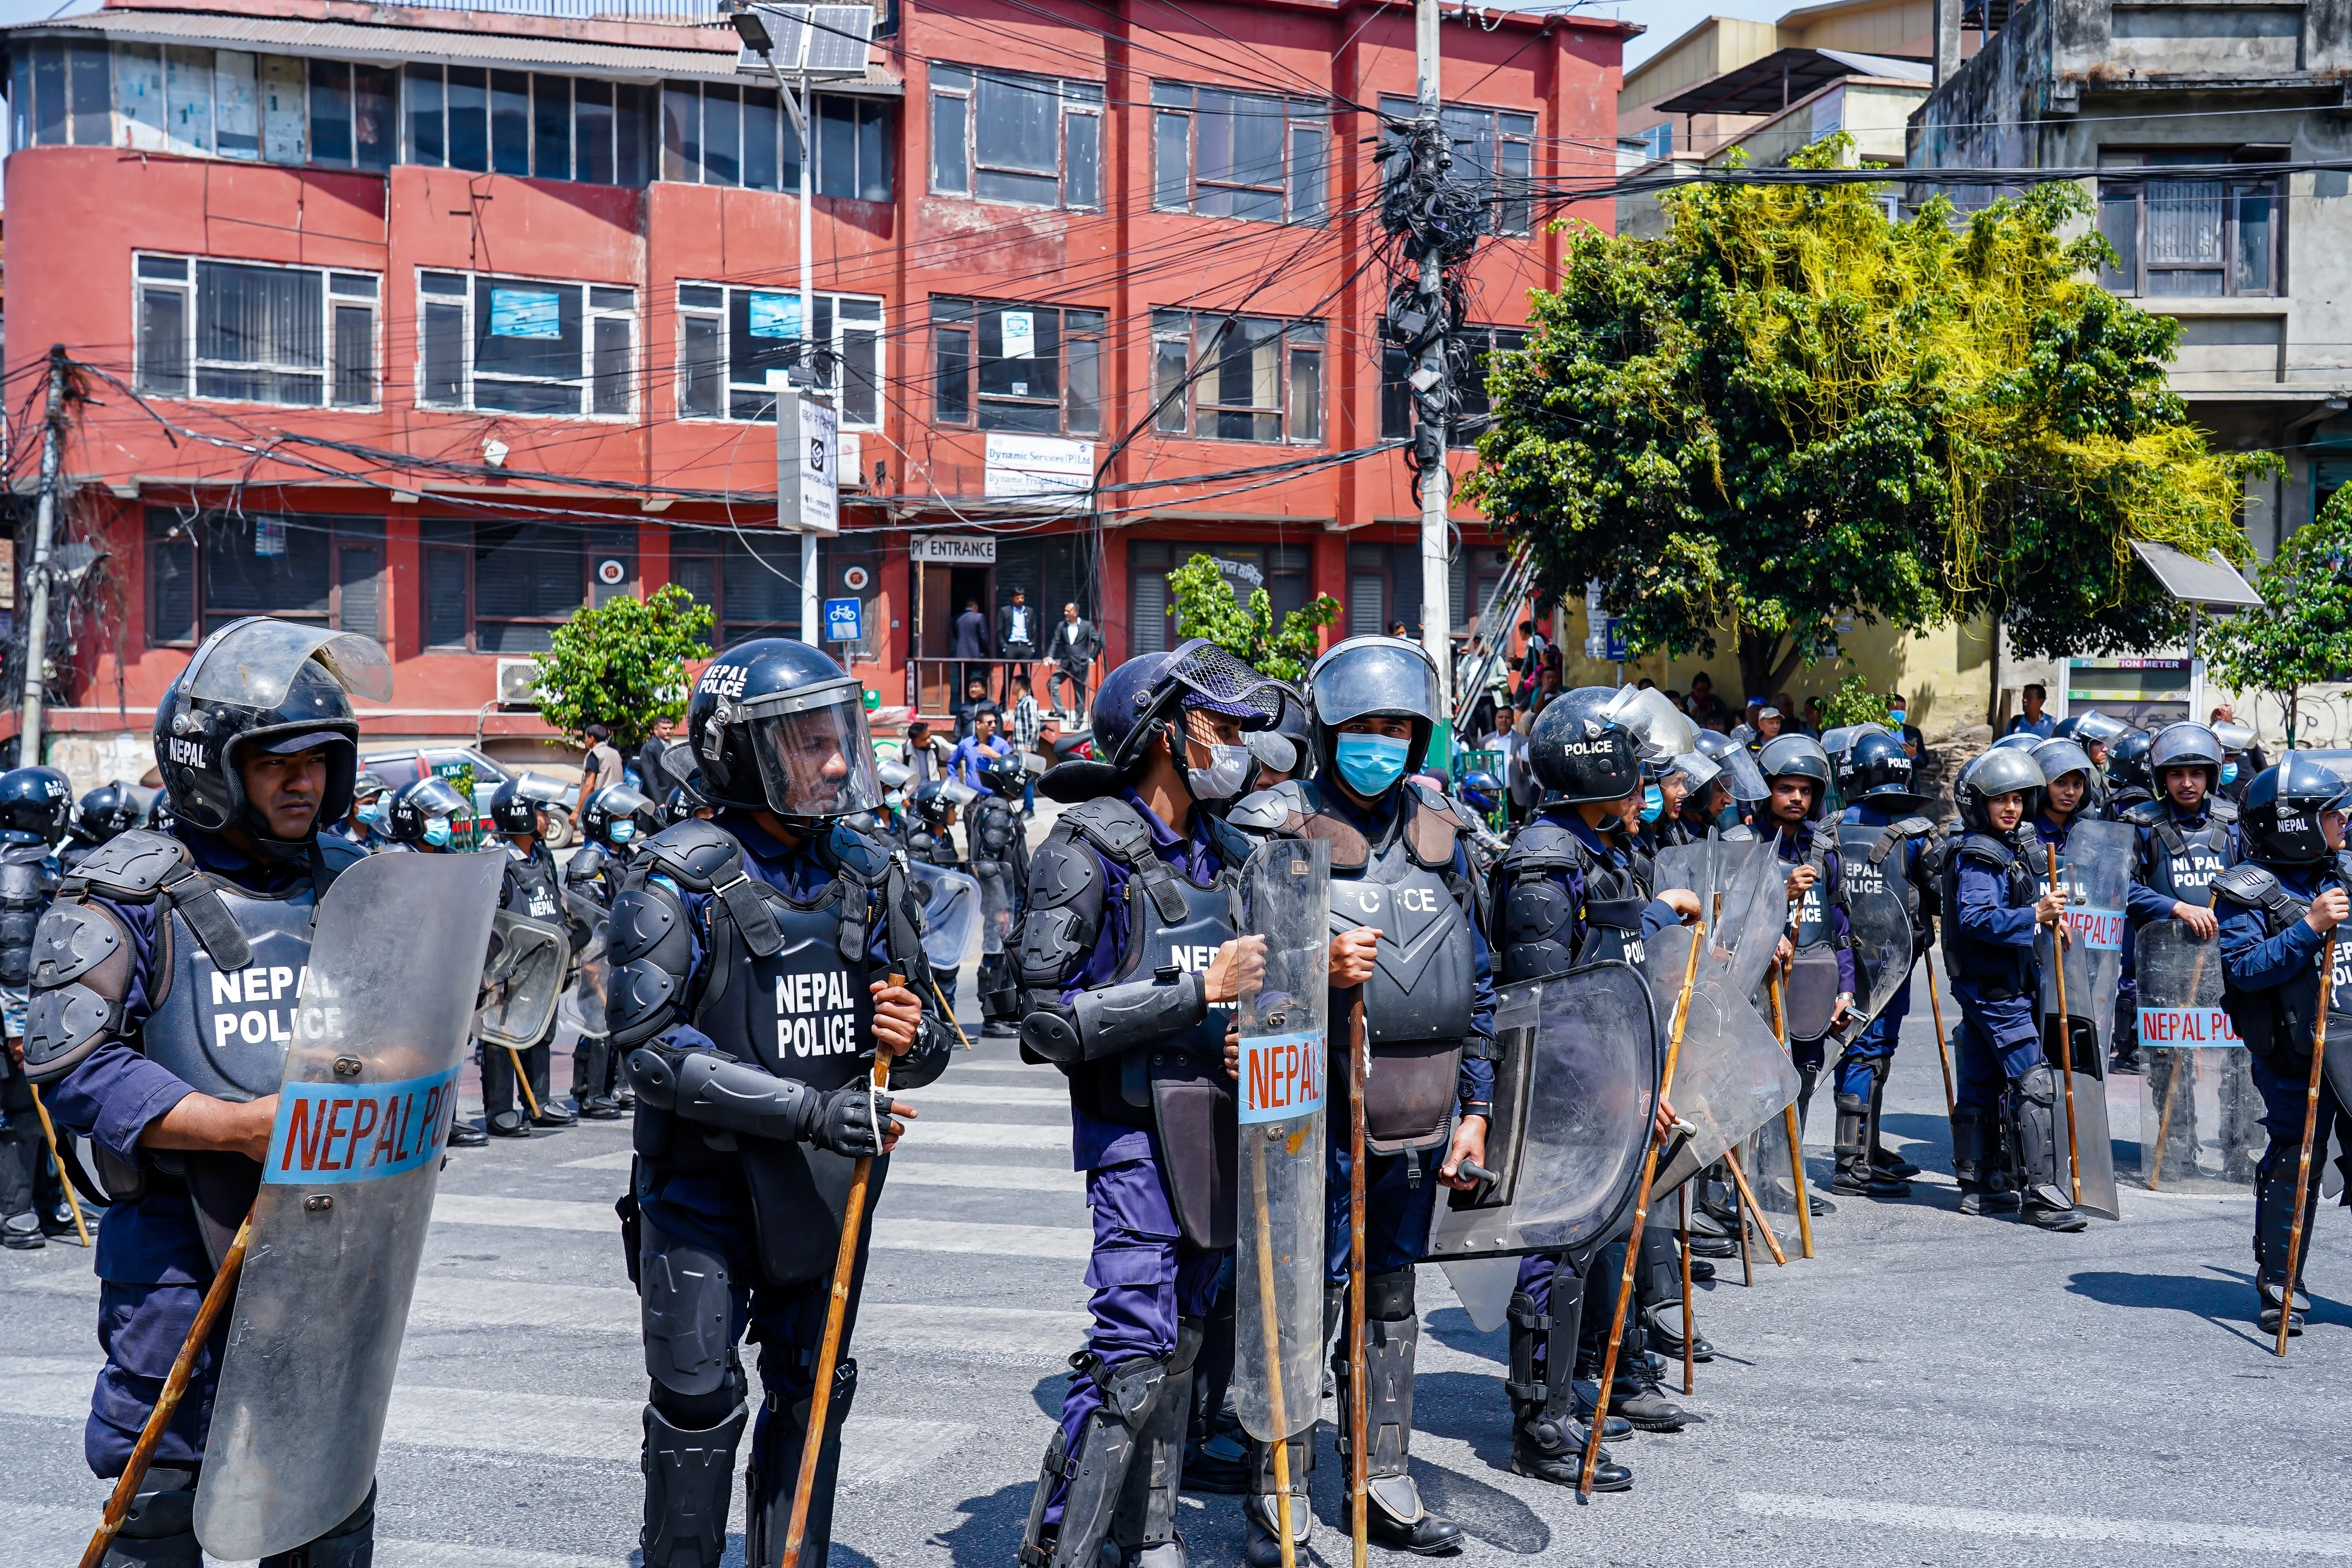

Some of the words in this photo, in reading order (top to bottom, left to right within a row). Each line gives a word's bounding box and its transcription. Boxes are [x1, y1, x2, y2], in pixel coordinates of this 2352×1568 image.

[990, 449, 1027, 461] Dynamic
[1030, 452, 1064, 462] Services
[990, 473, 1023, 485] Dynamic
[912, 540, 923, 555] PI
[931, 541, 994, 557] ENTRANCE
[2143, 660, 2179, 669] METER
[704, 665, 748, 682] NEPAL
[699, 679, 745, 697] POLICE
[170, 737, 206, 769] NEPAL
[1564, 740, 1613, 756] POLICE
[442, 764, 461, 776] KMC
[1840, 765, 1854, 776] NEPAL
[1888, 758, 1912, 769] POLICE
[1955, 793, 1972, 806] POLICE
[2277, 818, 2308, 832] NEPAL
[1846, 863, 1882, 878] EPAL
[1846, 880, 1882, 894] OLICE
[2174, 872, 2217, 888] POLIC
[529, 899, 556, 917] NEPAL
[211, 966, 339, 1005] NEPAL
[776, 971, 854, 1014] NEPAL
[215, 1007, 344, 1047] POLICE
[2143, 1013, 2206, 1041] NEPAL
[2212, 1013, 2244, 1041] PO
[777, 1014, 856, 1058] POLICE
[1248, 1041, 1319, 1110] NEPAL
[281, 1093, 414, 1171] NEPAL
